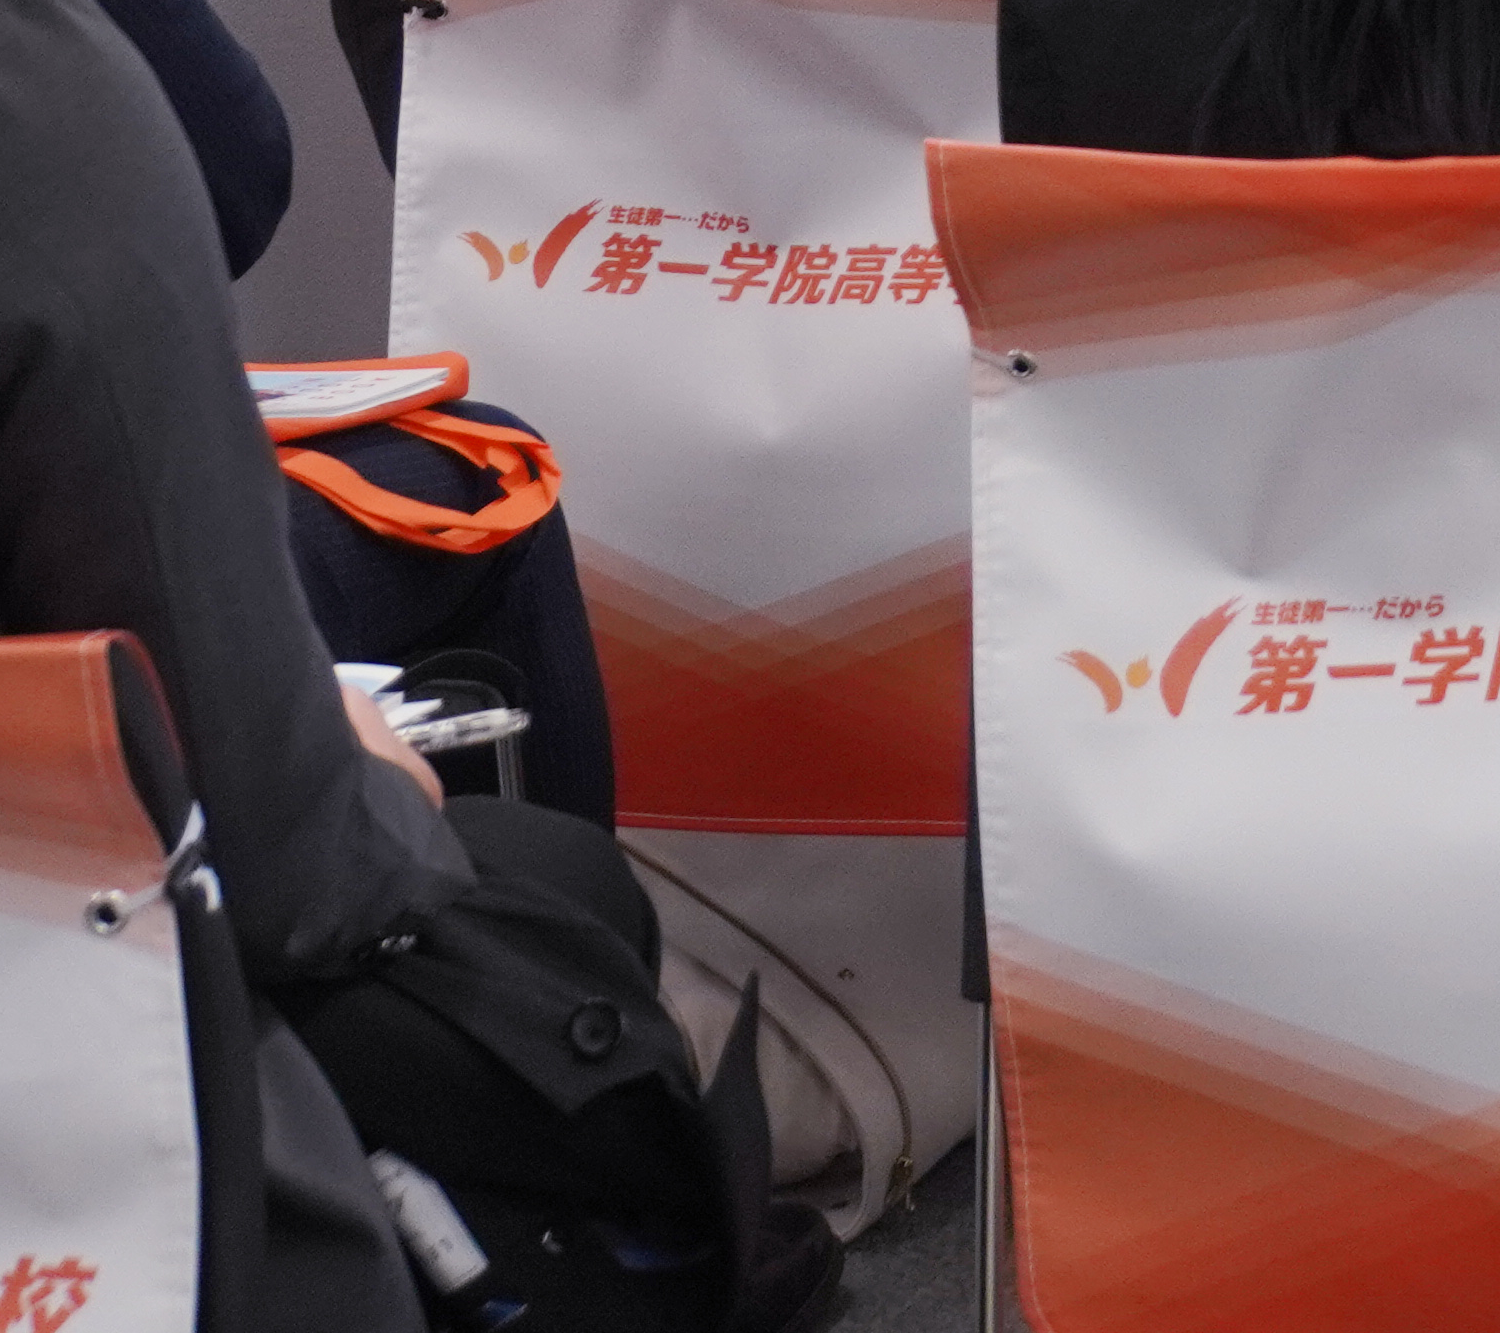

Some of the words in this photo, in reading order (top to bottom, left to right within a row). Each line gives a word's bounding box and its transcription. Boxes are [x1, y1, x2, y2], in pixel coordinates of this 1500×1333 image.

[584, 233, 964, 306] 第一学院高等
